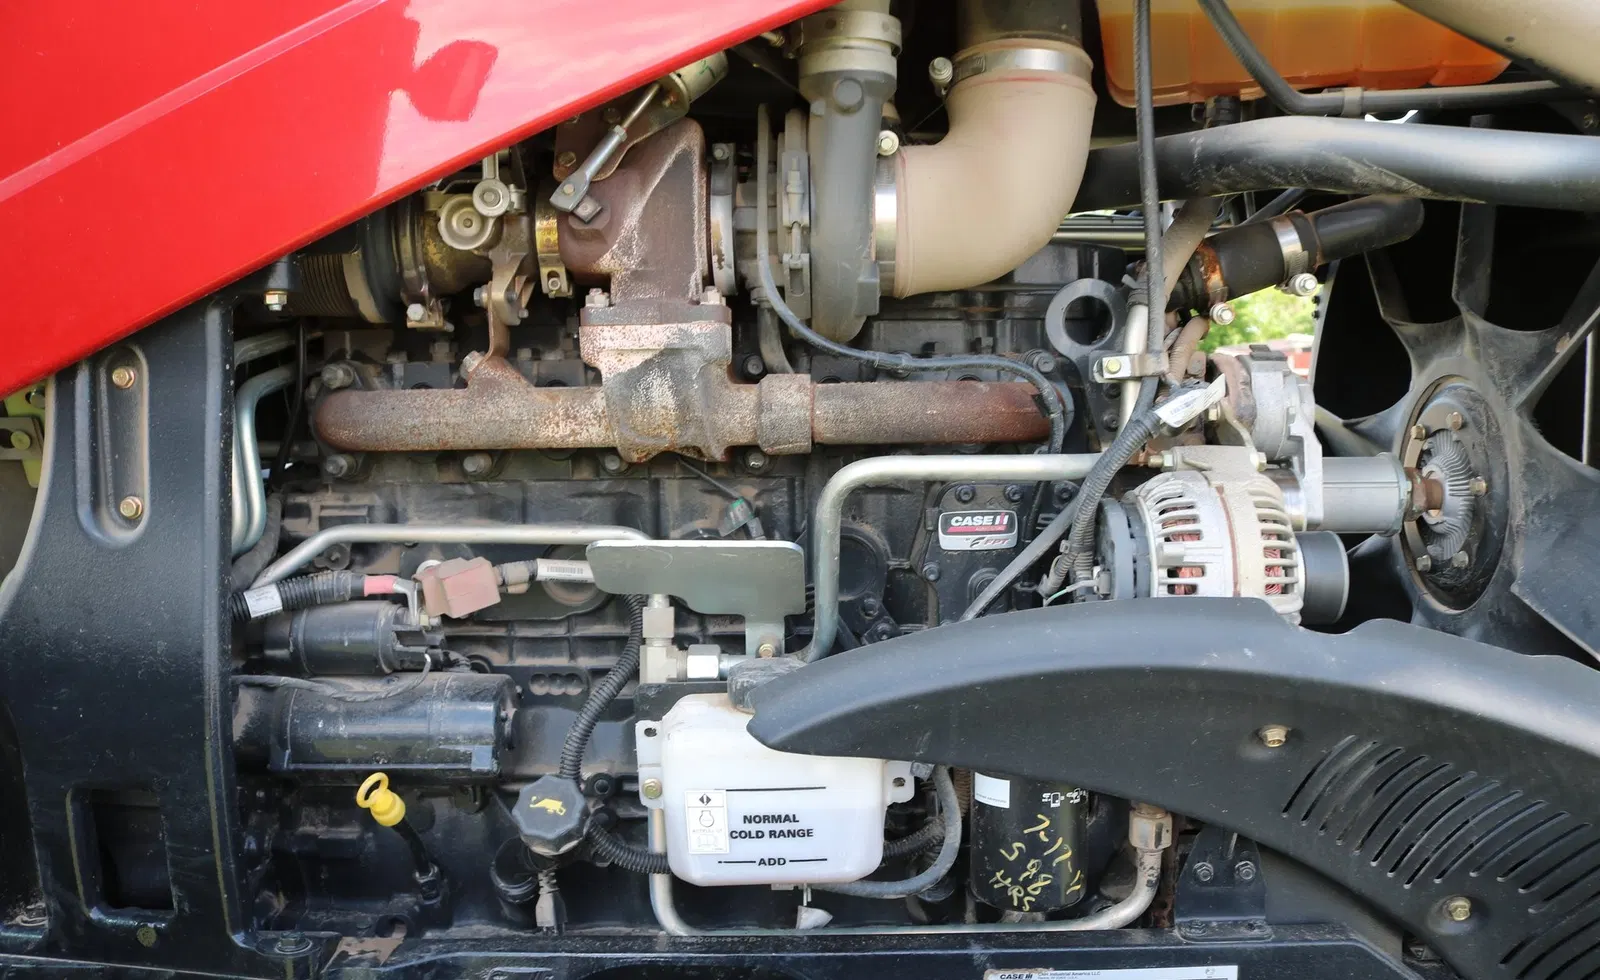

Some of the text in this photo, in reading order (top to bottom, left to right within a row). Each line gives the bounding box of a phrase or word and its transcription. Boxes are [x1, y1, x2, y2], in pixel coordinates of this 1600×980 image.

[951, 515, 994, 526] CASE
[743, 814, 799, 824] NORMAL
[730, 830, 765, 839] COLD
[768, 828, 814, 839] RANGE
[758, 857, 787, 866] ADD
